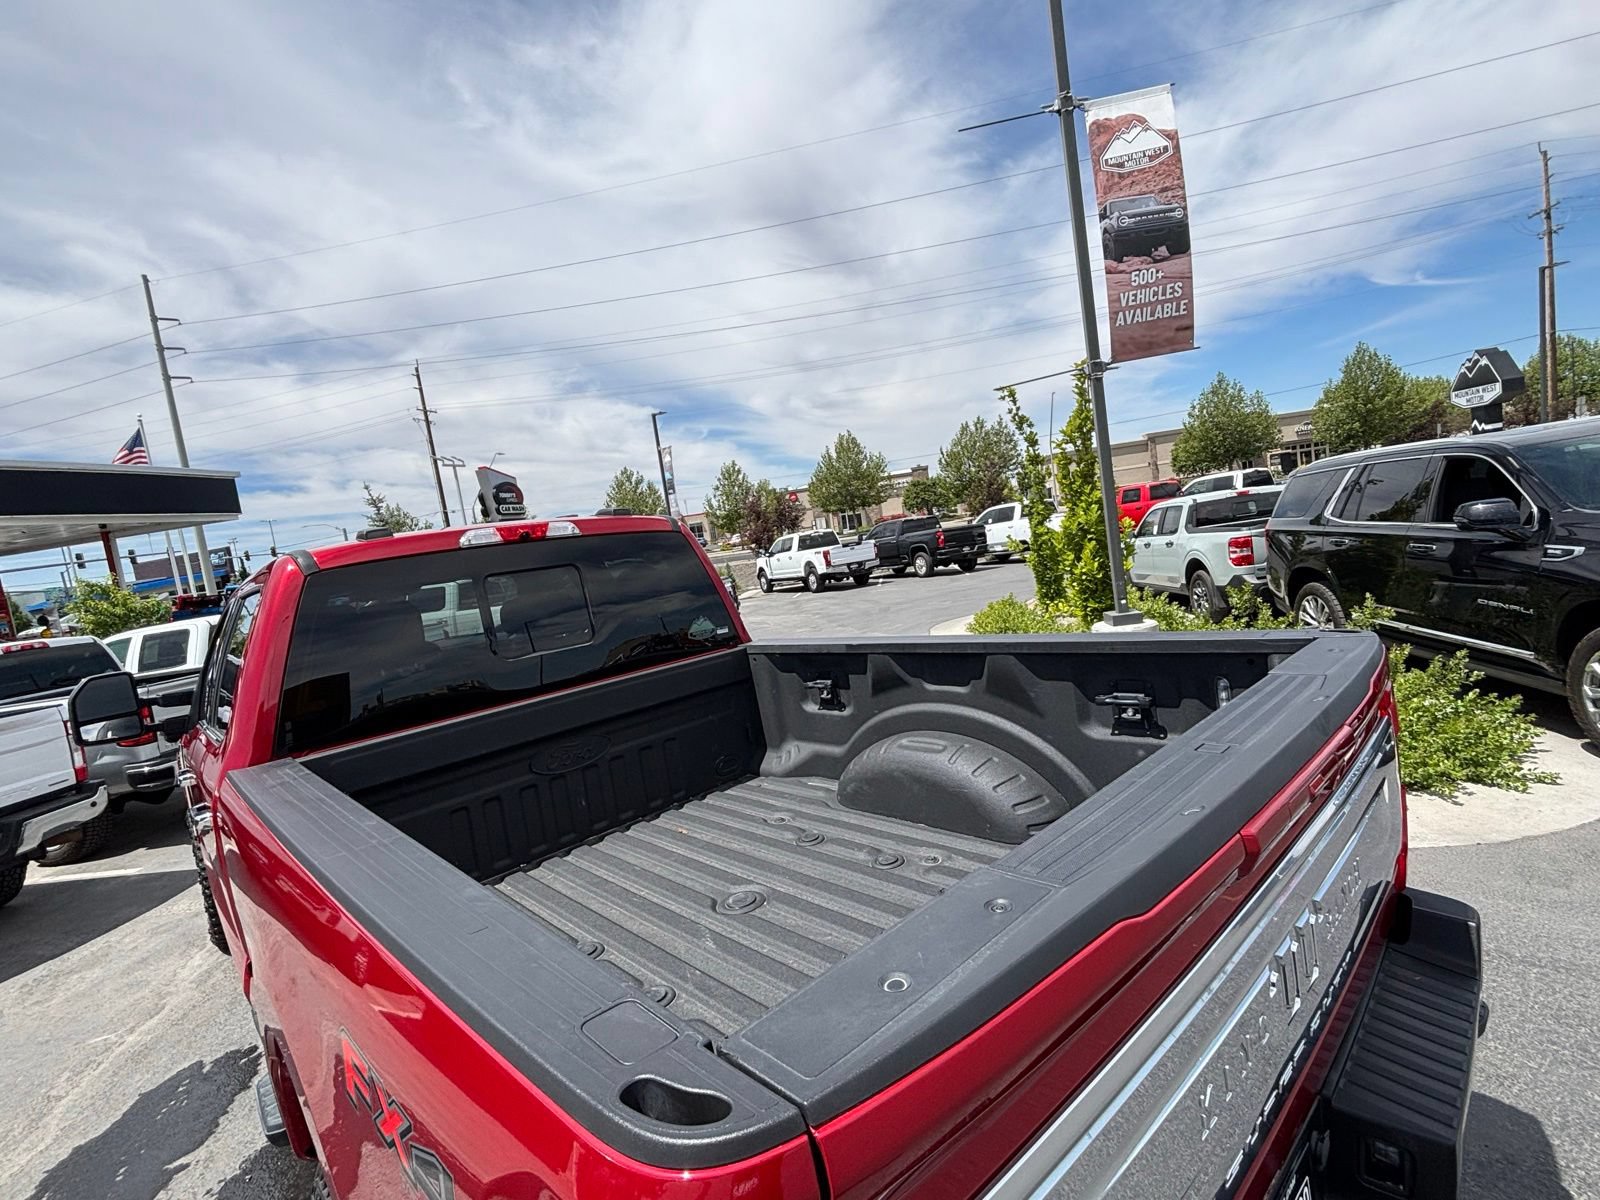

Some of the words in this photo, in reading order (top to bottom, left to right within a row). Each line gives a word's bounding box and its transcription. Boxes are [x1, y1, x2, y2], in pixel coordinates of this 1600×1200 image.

[1108, 151, 1144, 165] MOUNTAIN
[1145, 147, 1164, 157] WEST
[1125, 157, 1149, 168] MOTOR
[1131, 268, 1165, 286] 500+
[1120, 282, 1183, 307] VEHICLES
[1115, 299, 1189, 327] AVAILABLE
[1454, 389, 1480, 399] MOUNTAIN
[1481, 383, 1497, 393] WEST
[1466, 395, 1484, 403] MOTOR
